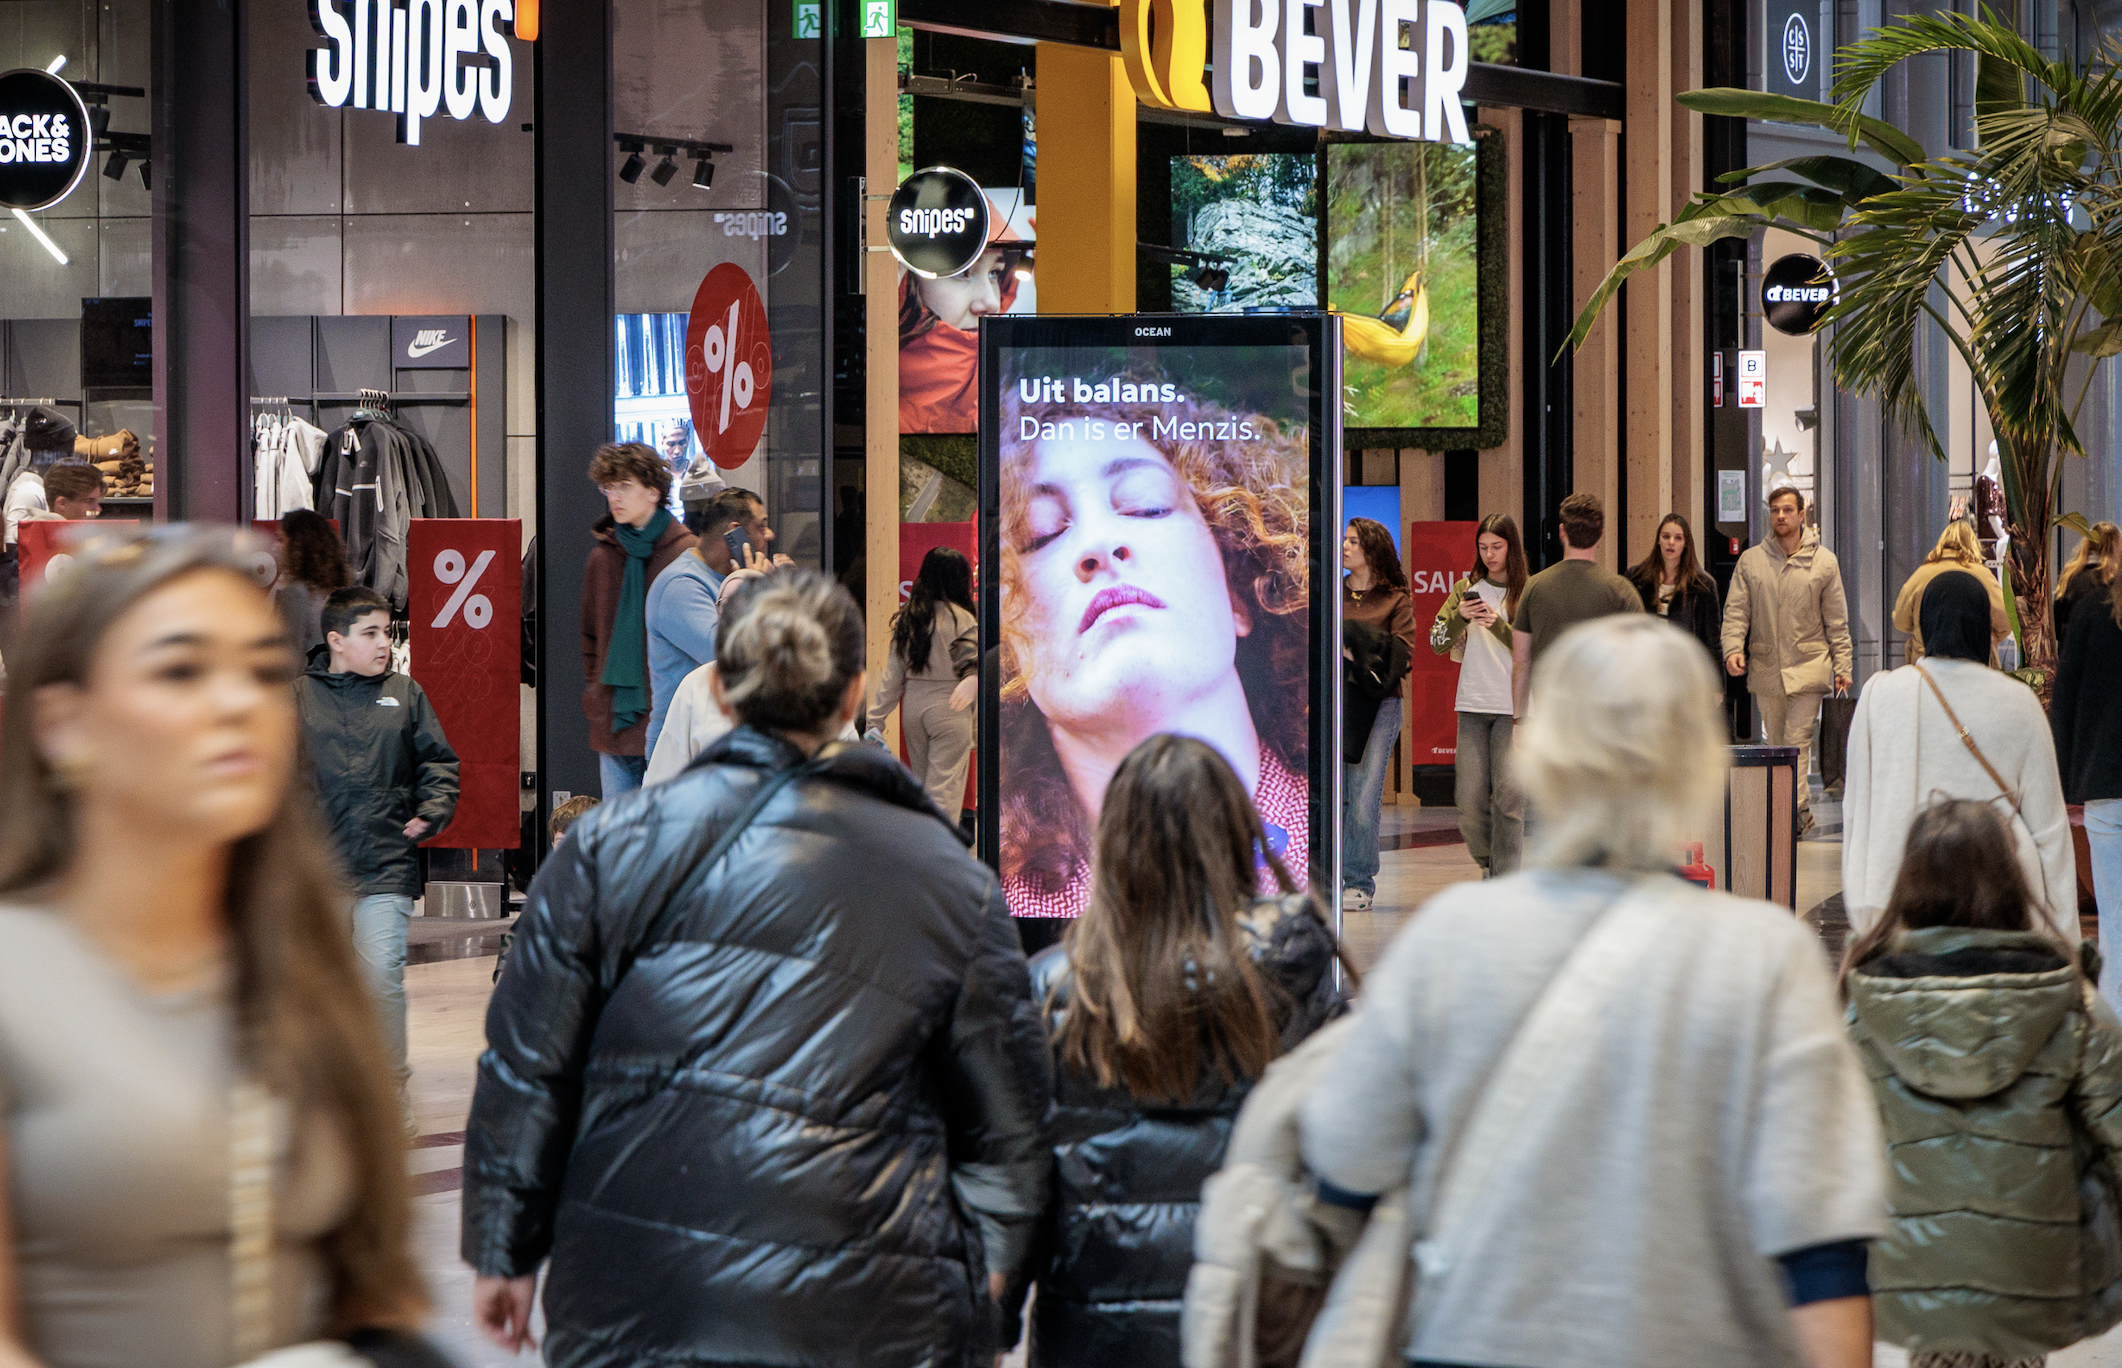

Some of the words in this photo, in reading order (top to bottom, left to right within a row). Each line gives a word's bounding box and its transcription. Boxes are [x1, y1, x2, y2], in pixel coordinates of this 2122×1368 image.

[316, 0, 513, 146] snipes
[1228, 0, 1471, 145] BEVER
[0, 113, 70, 139] ACK&
[0, 138, 70, 163] ONES
[900, 207, 966, 239] snipes
[1782, 287, 1829, 302] BEVER
[415, 329, 447, 346] NIKE
[1134, 326, 1172, 338] OCEAN
[703, 298, 755, 435] %
[1747, 359, 1757, 372] B
[1019, 375, 1066, 404] Uit
[1072, 377, 1186, 404] balans.
[1019, 415, 1075, 442] Dan
[1083, 415, 1106, 442] is
[1113, 420, 1144, 442] er
[1152, 414, 1262, 442] Menzis.
[430, 548, 497, 630] %
[1413, 570, 1472, 594] SAL
